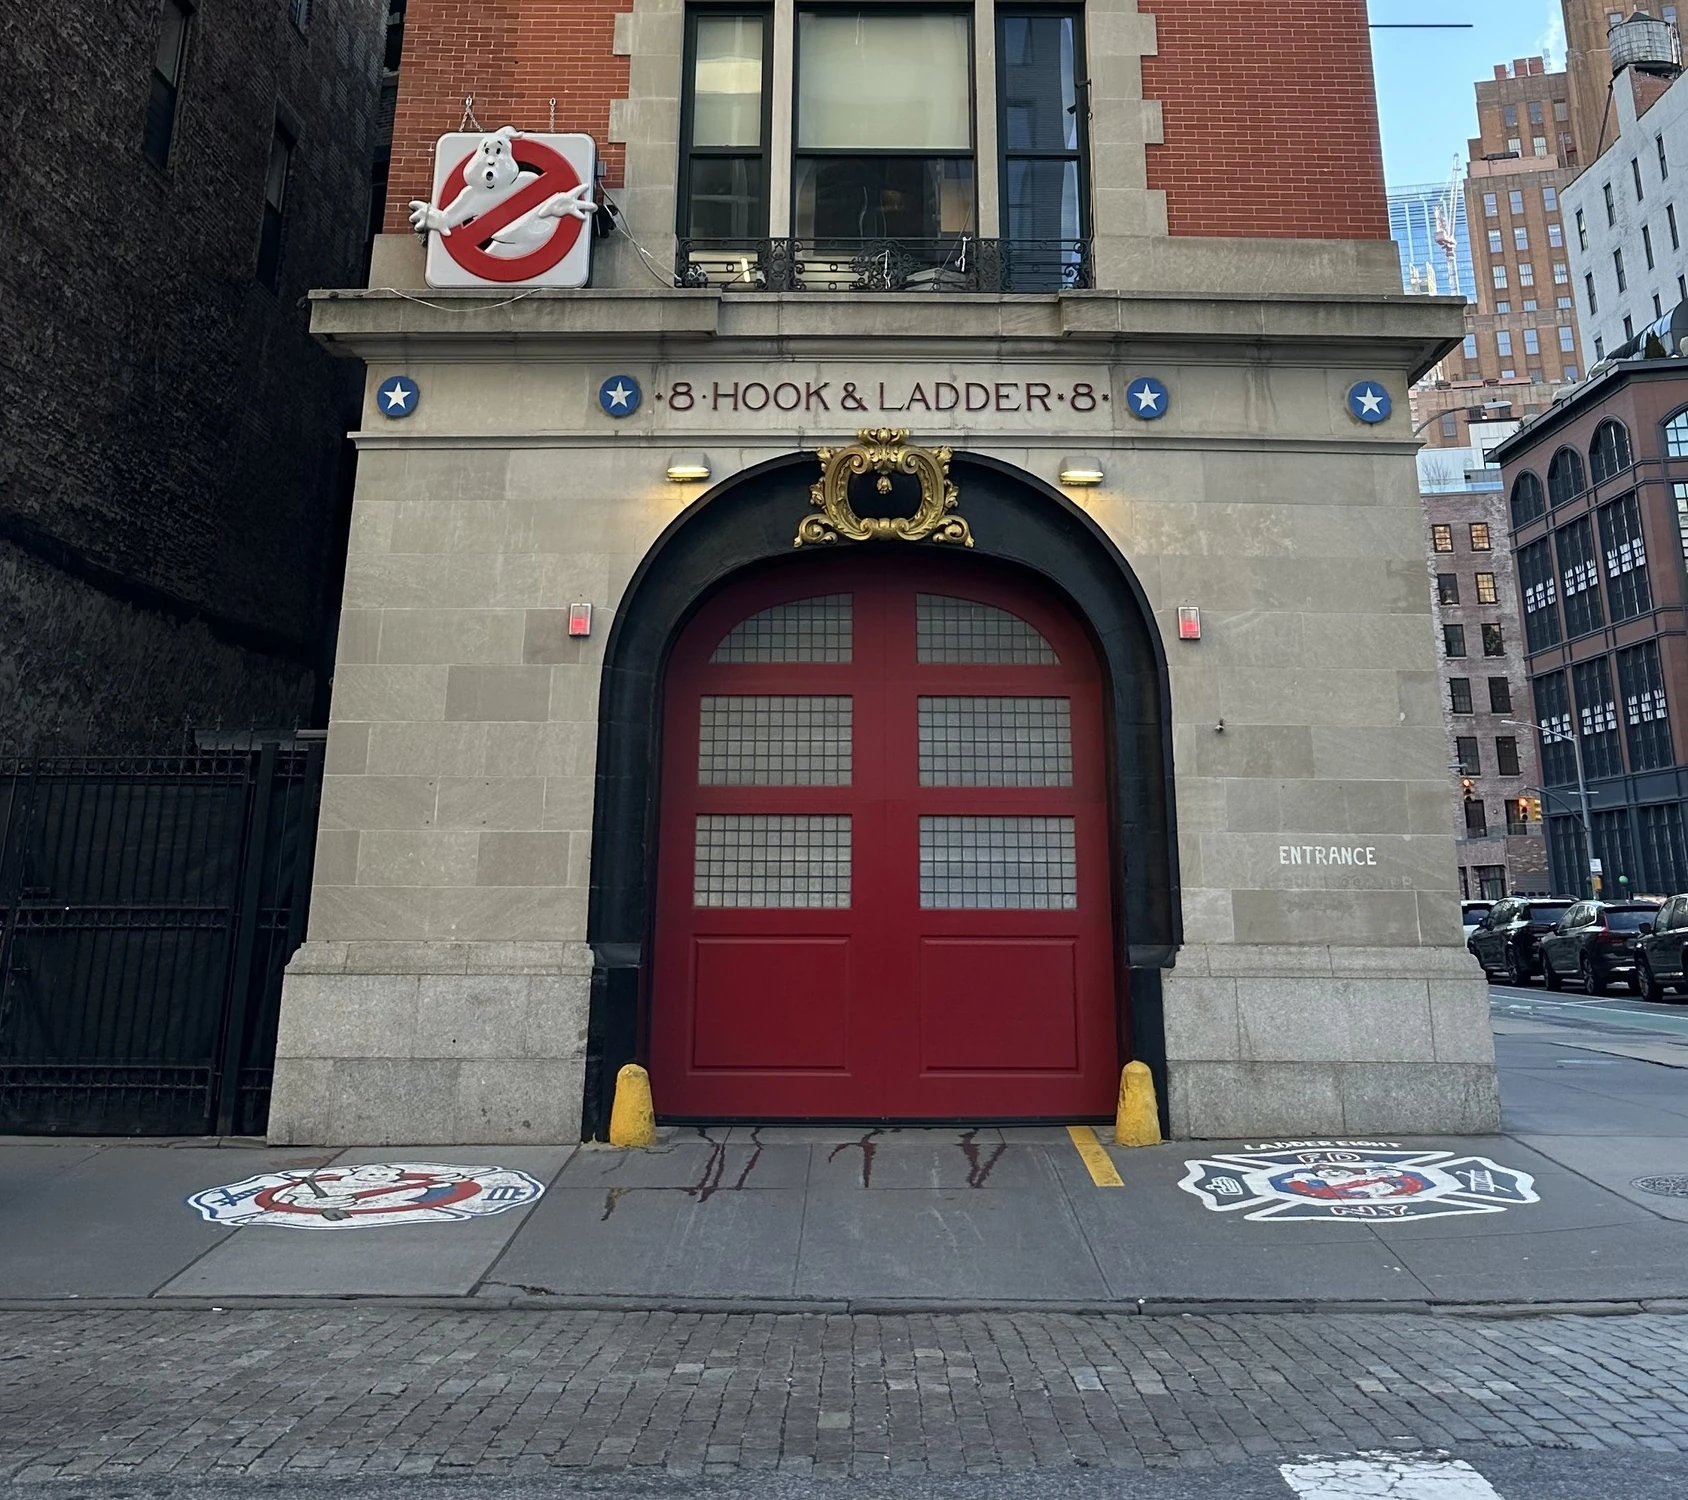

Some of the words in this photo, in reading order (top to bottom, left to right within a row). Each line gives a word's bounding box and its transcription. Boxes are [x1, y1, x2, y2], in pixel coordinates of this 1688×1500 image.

[1279, 845, 1377, 866] ENTRANCE
[1244, 1140, 1335, 1151] LADDER
[1336, 1140, 1402, 1149] EIGHT
